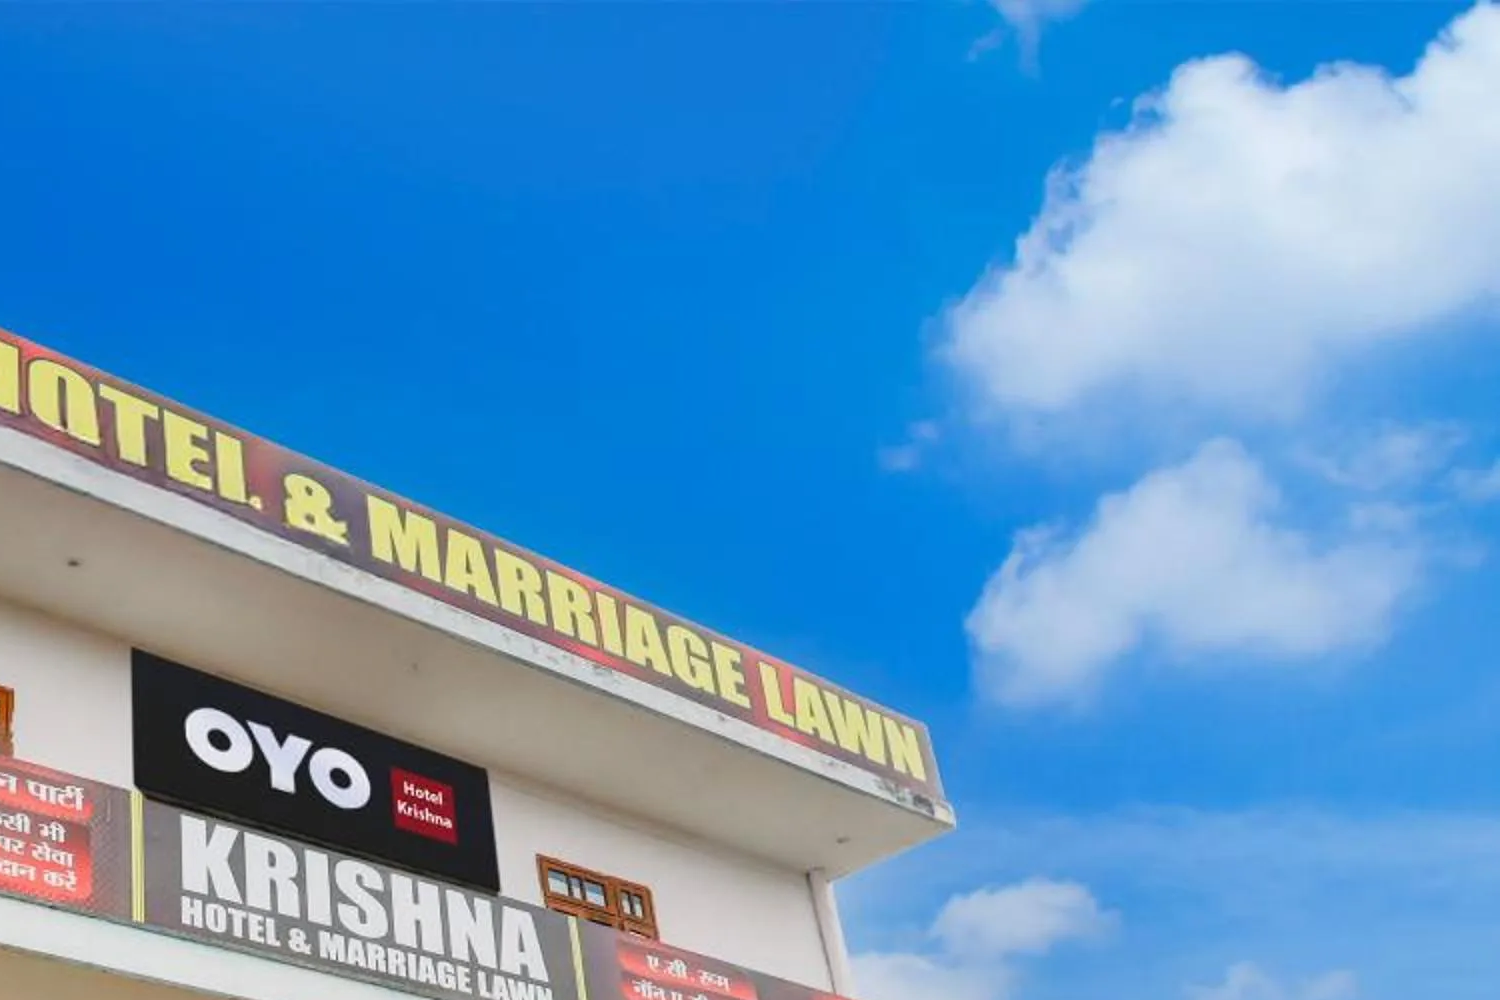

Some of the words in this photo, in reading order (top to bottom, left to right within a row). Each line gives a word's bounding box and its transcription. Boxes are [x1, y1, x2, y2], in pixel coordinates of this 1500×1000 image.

[284, 473, 349, 546] &
[366, 493, 750, 709] MARRIAGE
[758, 661, 927, 782] LAWN
[184, 707, 371, 809] OYO
[26, 779, 85, 811] पार्टी
[403, 781, 443, 806] Hotel
[397, 799, 453, 829] Krishna
[38, 822, 66, 843] भी
[30, 841, 76, 868] सेवा
[180, 813, 549, 983] KRISHNA
[181, 895, 280, 947] HOTEL
[287, 926, 311, 955] &
[319, 930, 472, 995] MARRIAGE
